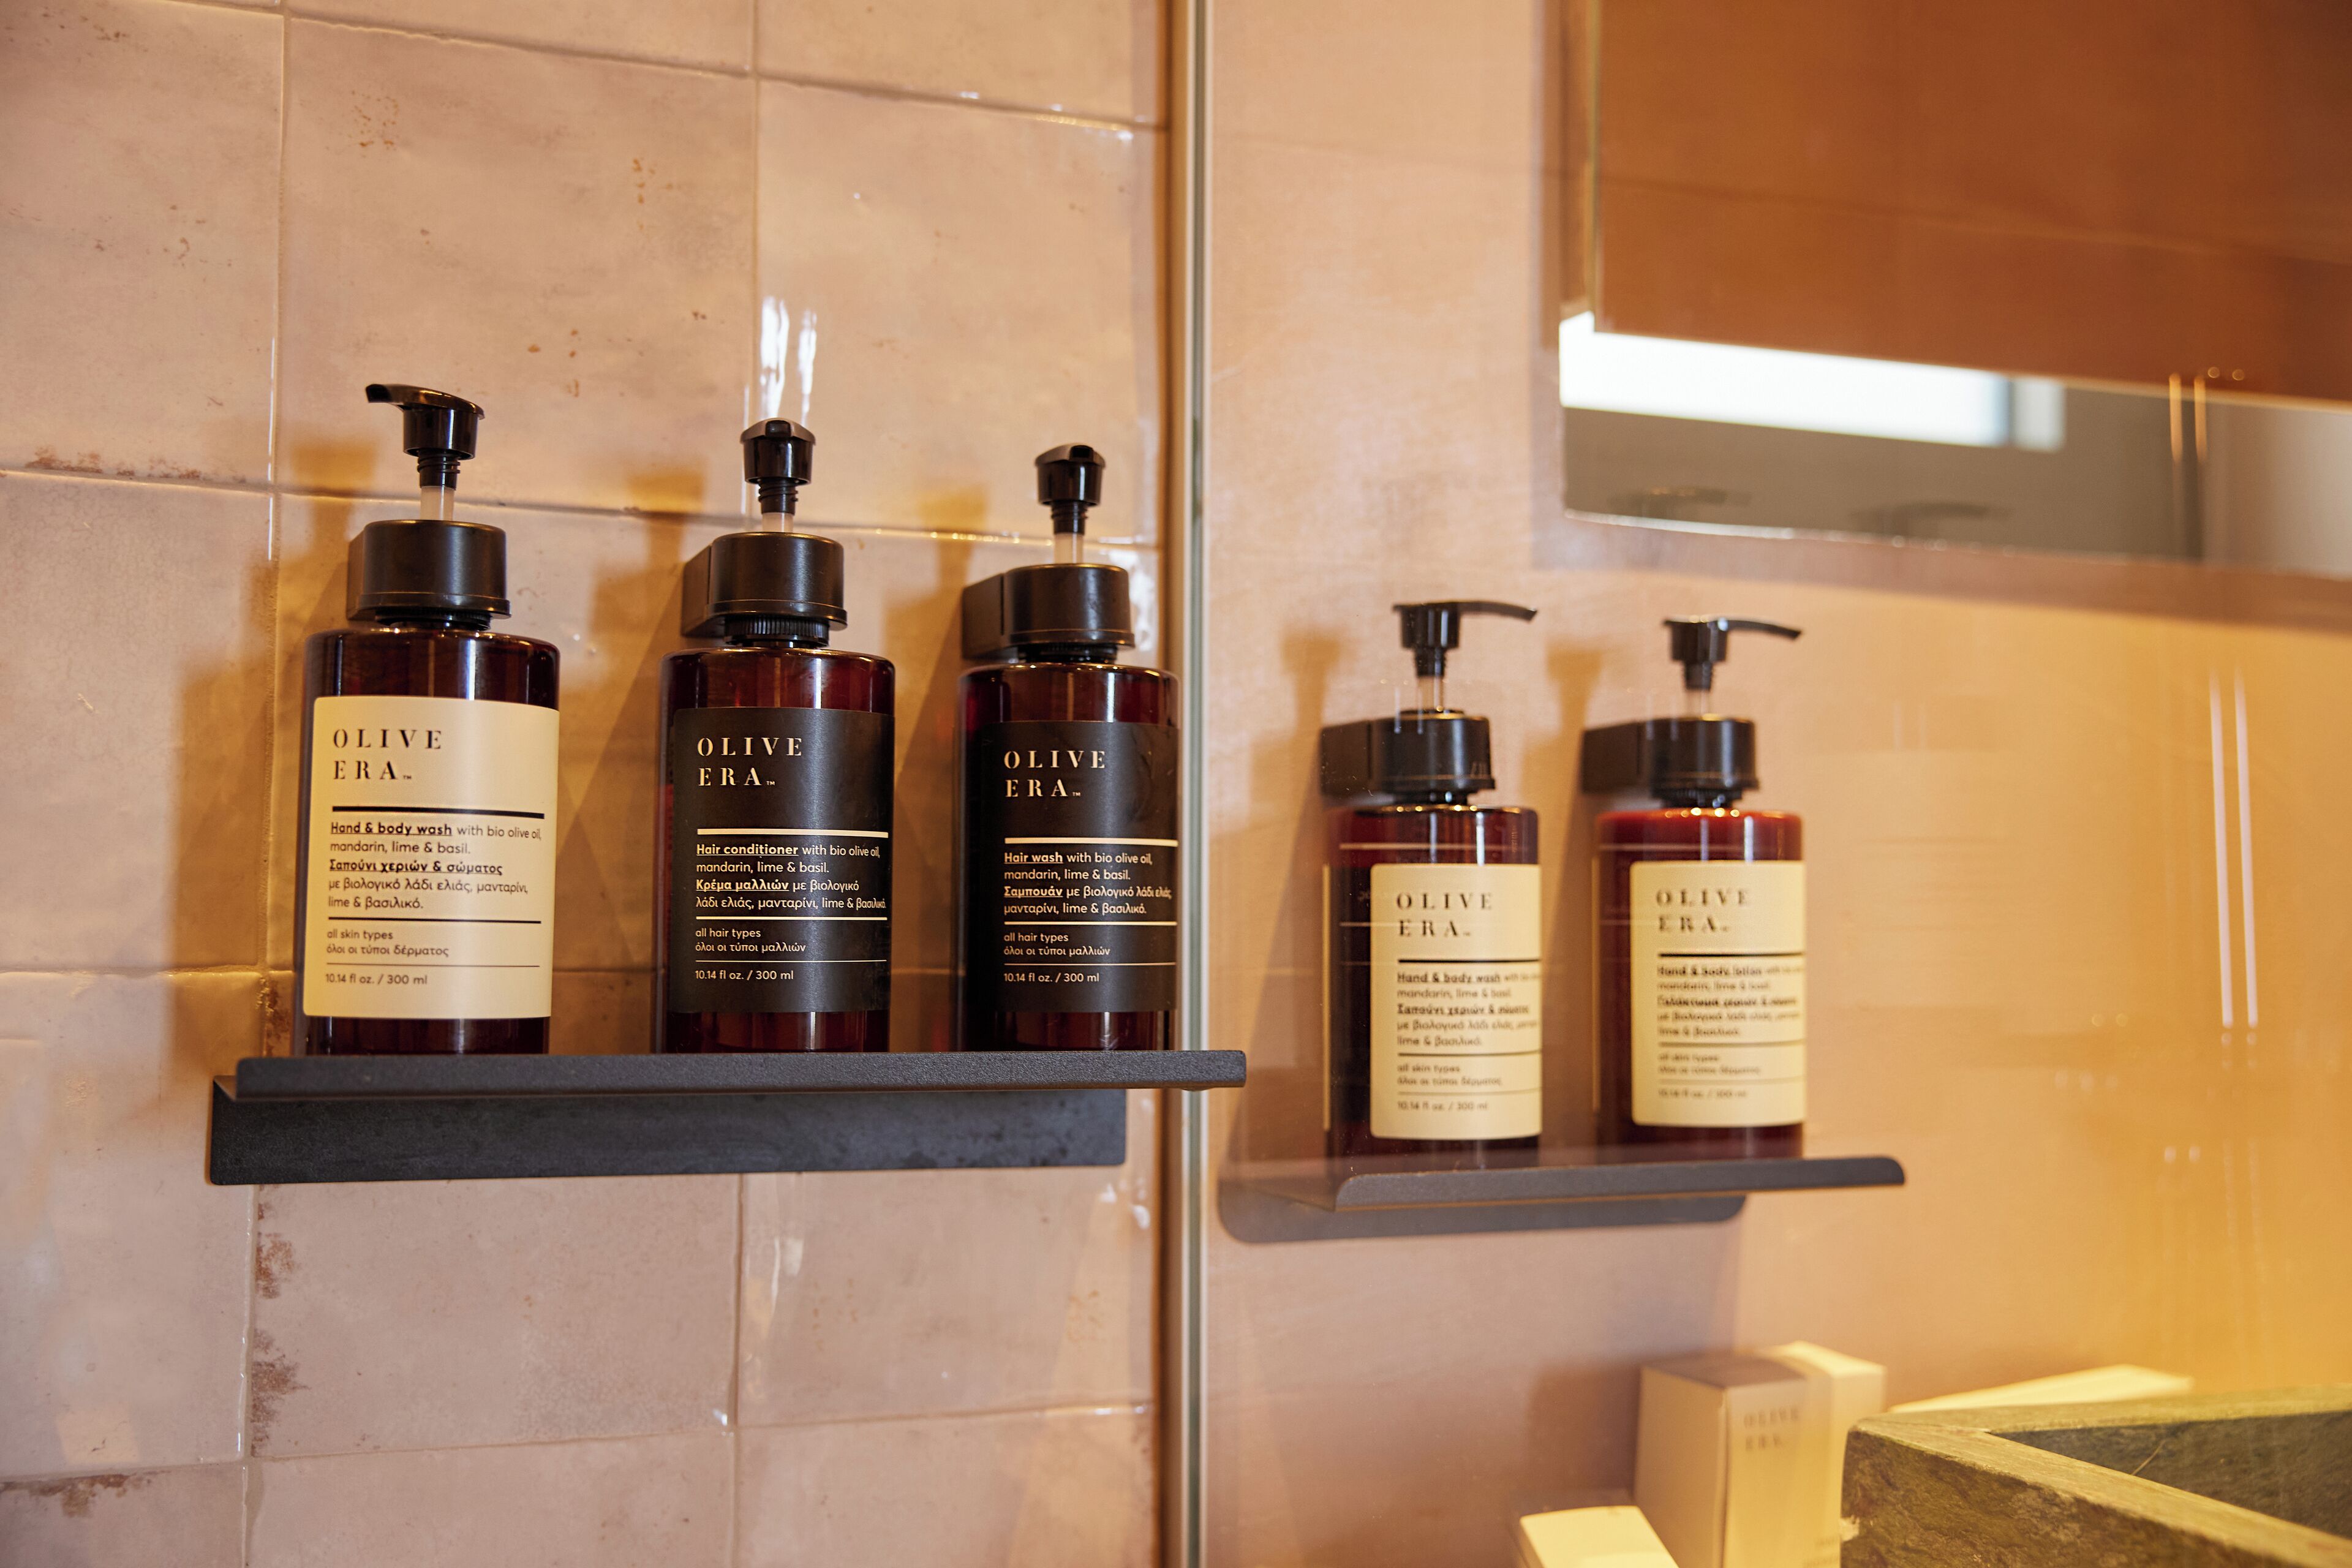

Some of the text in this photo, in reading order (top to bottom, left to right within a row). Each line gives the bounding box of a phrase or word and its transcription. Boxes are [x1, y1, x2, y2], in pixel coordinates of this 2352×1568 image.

[333, 729, 441, 749] OLIVE
[698, 737, 802, 756] OLIVE
[1004, 751, 1105, 769] OLIVE
[331, 823, 360, 834] Hand
[365, 823, 373, 832] &
[379, 823, 412, 835] body
[417, 824, 452, 835] wash
[457, 826, 483, 835] with
[488, 827, 504, 837] bio
[508, 827, 529, 839] olive
[330, 842, 470, 854] mandarin, lime & basil.
[697, 844, 880, 858] Hair conditioner with bio olive oil,
[1005, 852, 1152, 864] Hair wash with bio olive oil,
[330, 860, 502, 875] Σαπούνι χεριών & σώματος
[696, 862, 829, 873] mandarin, lime & basil.
[1005, 869, 1131, 881] mandarin, lime & basil.
[329, 881, 340, 891] με
[344, 878, 401, 892] βιολογικό
[405, 879, 432, 890] λάδι
[437, 880, 473, 892] ελιάς,
[696, 880, 859, 892] Κρέμα μαλλιών με βιολογικό
[1004, 886, 1063, 898] Σαμπουάν
[1066, 888, 1080, 899] με
[1084, 886, 1133, 899] βιολογικό
[1136, 886, 1153, 897] λάδι
[1656, 889, 1748, 907] OLIVE
[328, 897, 423, 910] lime & βασιλικό.
[696, 897, 886, 910] λάδι ελιάς, μανταρίνι, lime & βασιλικό.
[1396, 892, 1492, 910] OLIVE
[1004, 903, 1147, 916] μανταρίνι, lime & βασιλικό.
[327, 930, 393, 941] all skin types
[695, 929, 761, 939] all hair types
[1004, 933, 1069, 943] all hair types
[326, 944, 345, 954] όλοι
[361, 945, 390, 954] τύποι
[394, 946, 448, 957] δέρματος
[695, 943, 714, 952] όλοι
[730, 943, 758, 952] τύποι
[761, 943, 806, 954] μαλλιών
[1004, 946, 1023, 955] όλοι
[1039, 946, 1066, 956] τύποι
[1069, 947, 1110, 957] μαλλιών
[326, 973, 345, 984] 10.14
[350, 973, 356, 984] fl
[378, 974, 384, 985] /
[387, 974, 409, 985] 300
[413, 974, 428, 985] ml
[695, 971, 716, 979] 10.14
[720, 970, 726, 979] fl
[747, 970, 753, 980] /
[756, 971, 777, 979] 300
[780, 971, 794, 979] ml
[1004, 973, 1025, 982] 10.14
[1028, 973, 1035, 982] fl
[1055, 973, 1060, 983] /
[1064, 973, 1084, 982] 300
[1087, 973, 1099, 982] ml
[1398, 972, 1427, 982] Hand
[1432, 973, 1439, 982] &
[1444, 973, 1471, 984] body
[1476, 973, 1500, 983] wash
[1456, 989, 1478, 998] lime
